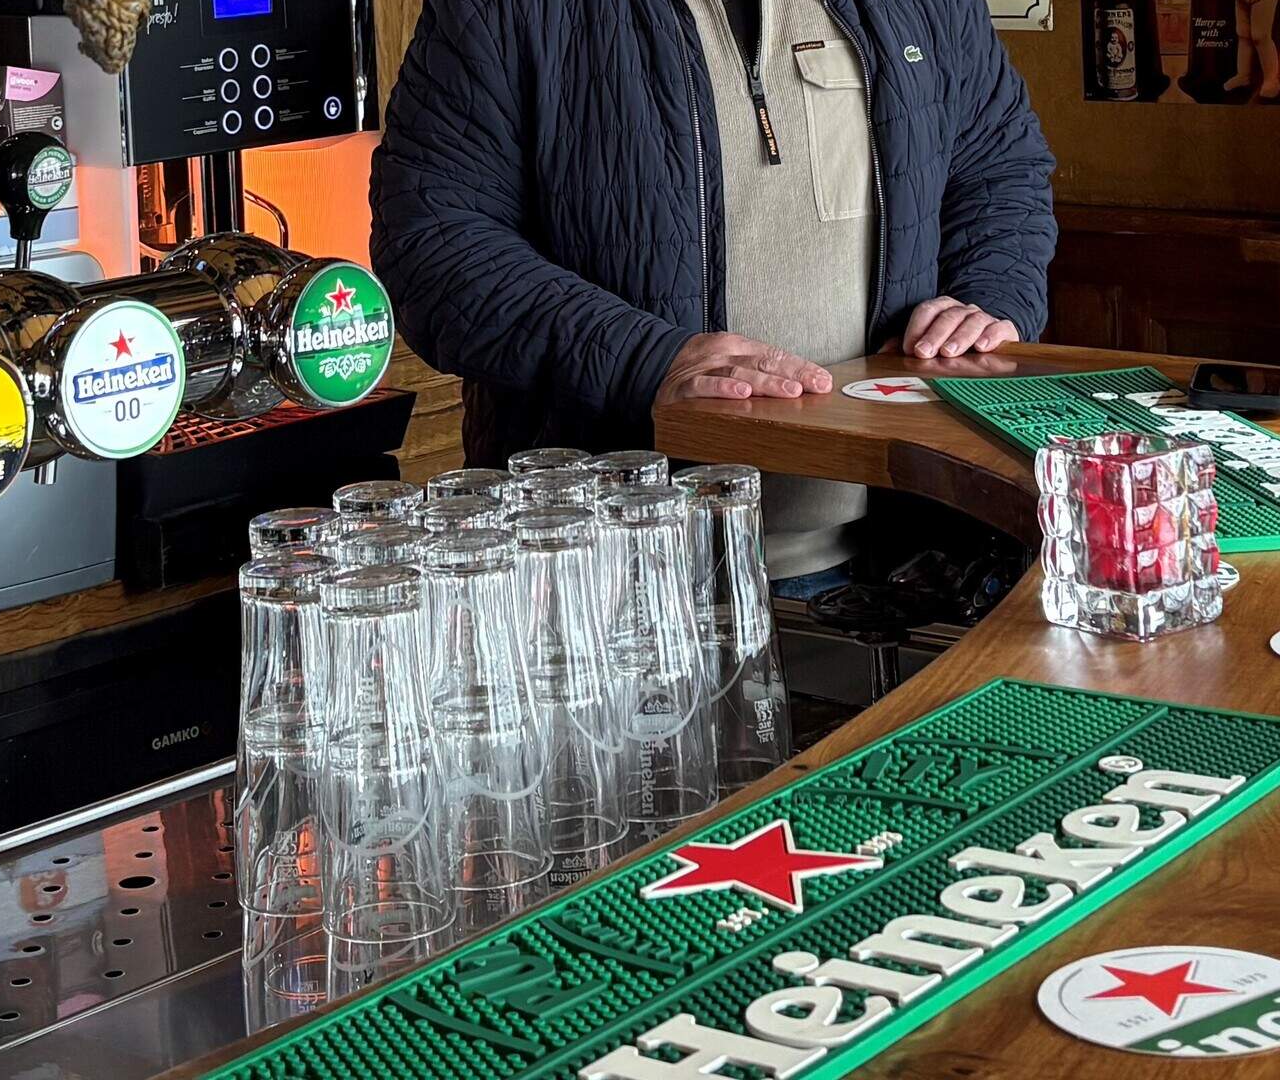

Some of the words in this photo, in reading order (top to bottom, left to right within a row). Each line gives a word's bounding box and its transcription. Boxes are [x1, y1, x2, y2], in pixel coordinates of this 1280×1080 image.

[297, 317, 390, 354] Heineken
[76, 360, 172, 399] Heineken
[151, 726, 200, 751] GAMKO
[577, 766, 1247, 1080] Heineken
[1118, 1014, 1155, 1030] EST.
